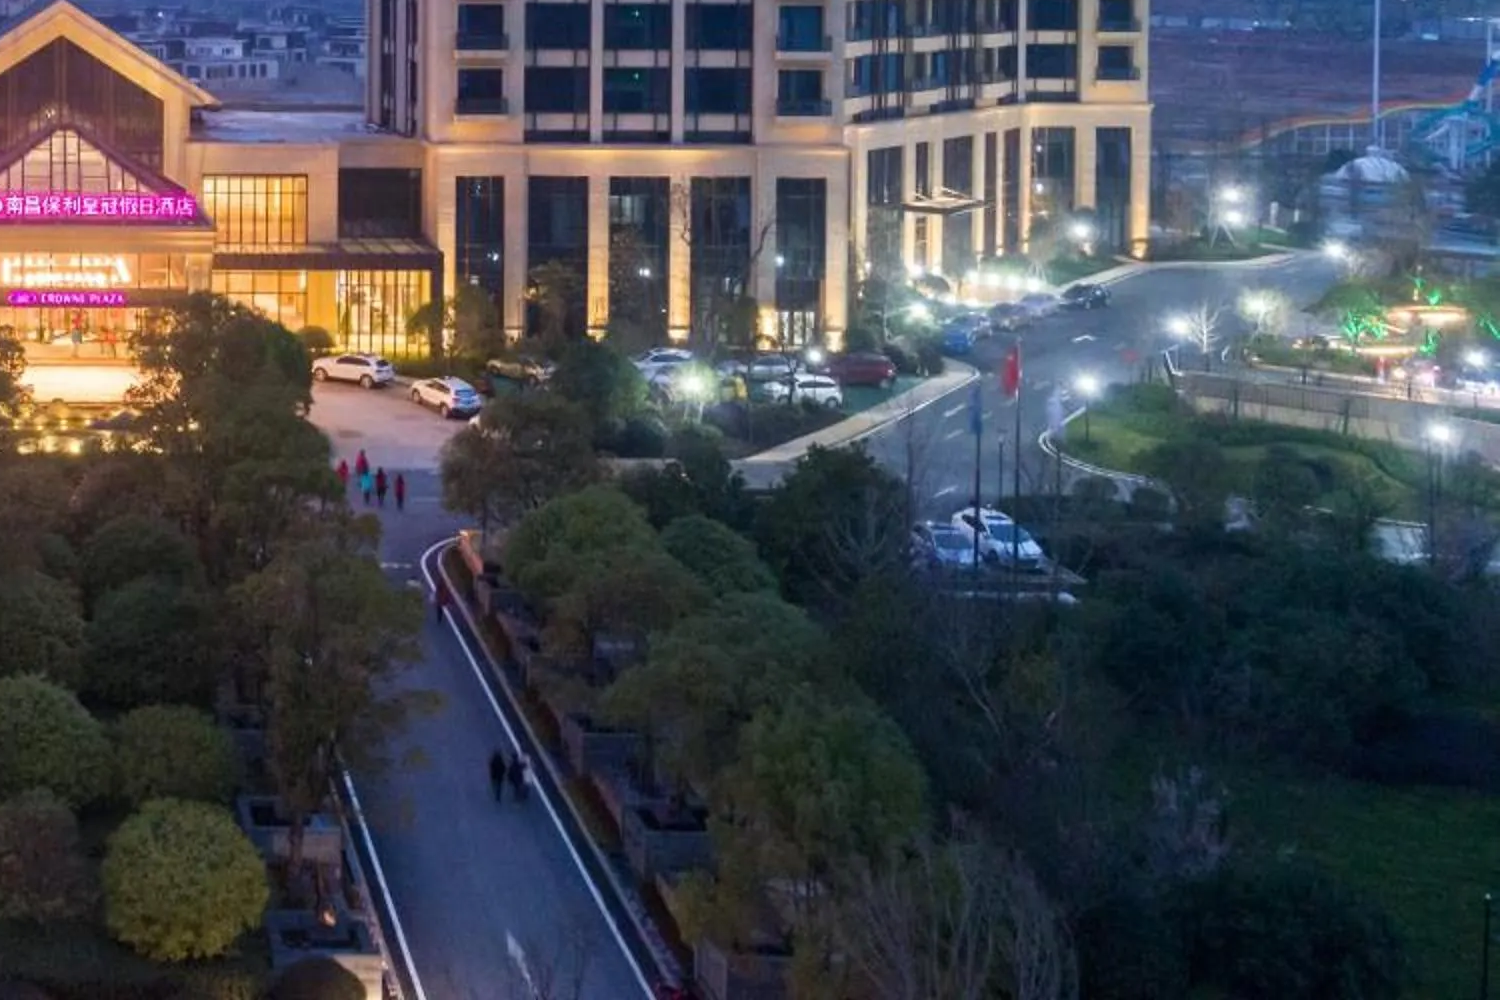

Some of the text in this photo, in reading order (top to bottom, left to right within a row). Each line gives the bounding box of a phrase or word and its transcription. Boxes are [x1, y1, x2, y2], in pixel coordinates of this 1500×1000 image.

[5, 194, 194, 217] 南昌保利皇冠假日酒店
[41, 293, 124, 304] CROWNE PLAZA
